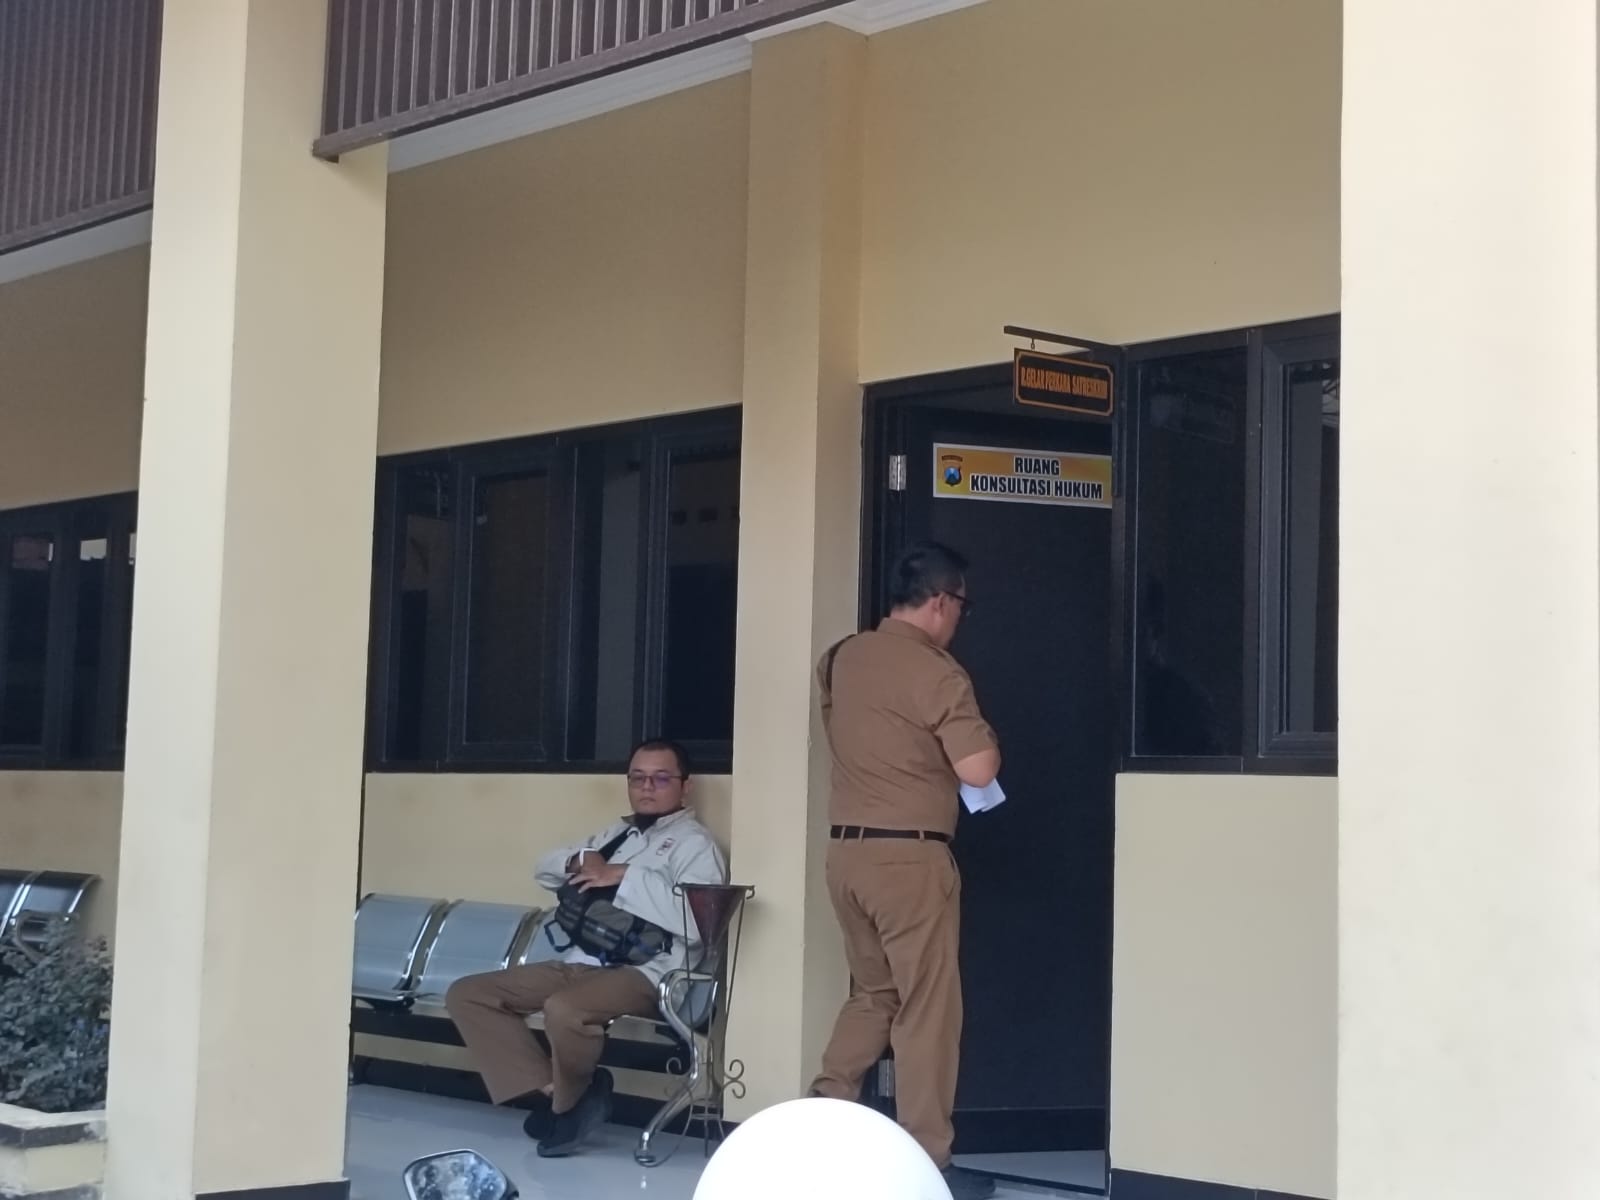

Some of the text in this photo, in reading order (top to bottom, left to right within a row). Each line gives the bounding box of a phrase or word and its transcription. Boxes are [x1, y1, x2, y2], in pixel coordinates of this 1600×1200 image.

[1014, 457, 1060, 476] RUANG
[970, 475, 1102, 499] KONSULTASI HUKUM
